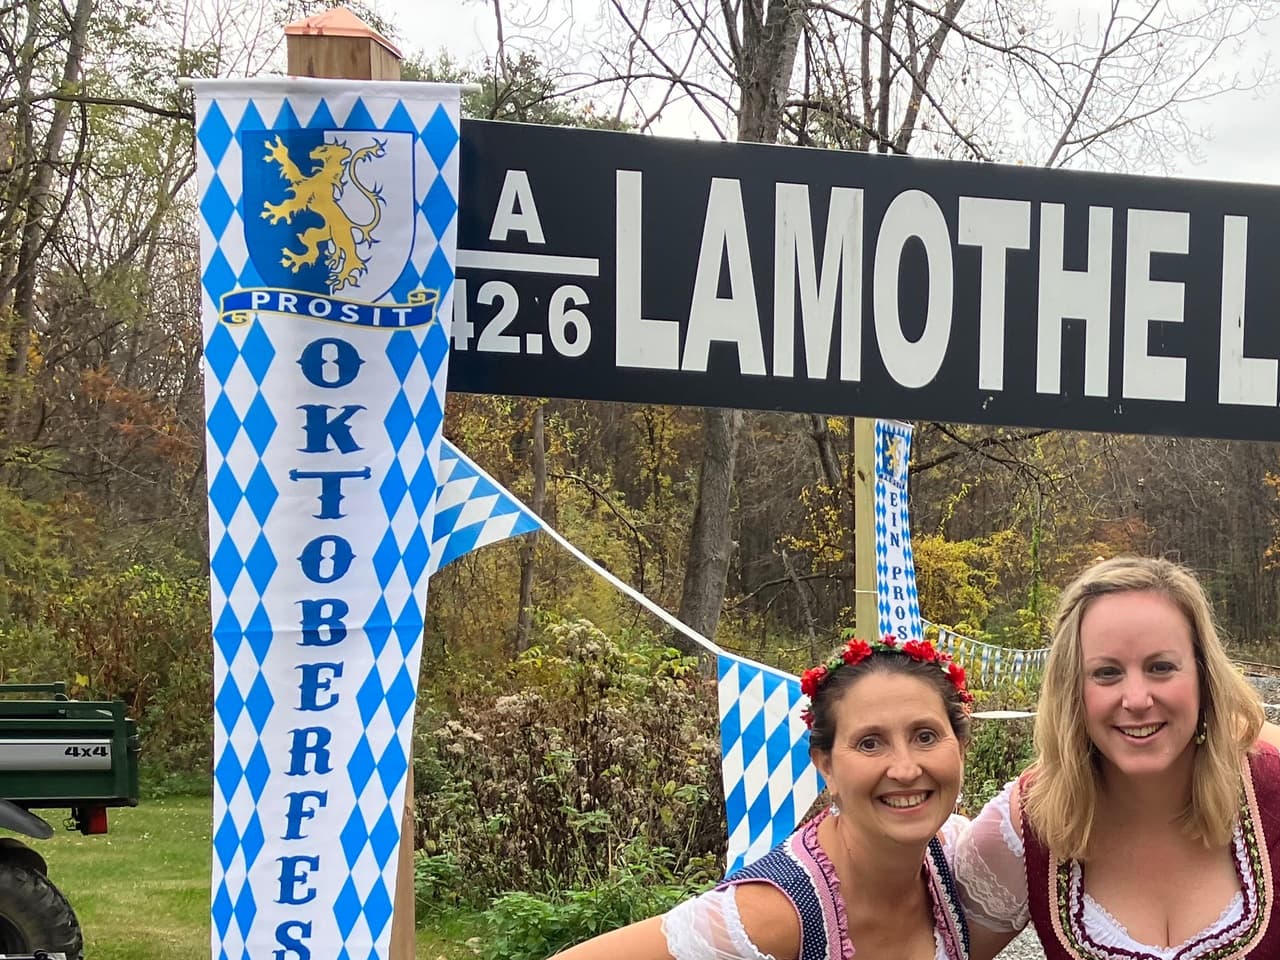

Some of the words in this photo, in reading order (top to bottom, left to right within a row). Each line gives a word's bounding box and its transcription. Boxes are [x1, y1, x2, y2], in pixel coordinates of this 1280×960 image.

[488, 169, 546, 245] A
[251, 291, 412, 328] PROSIT
[615, 169, 1191, 402] LAMOTHE
[890, 492, 900, 548] EIN
[64, 746, 109, 758] 4x4
